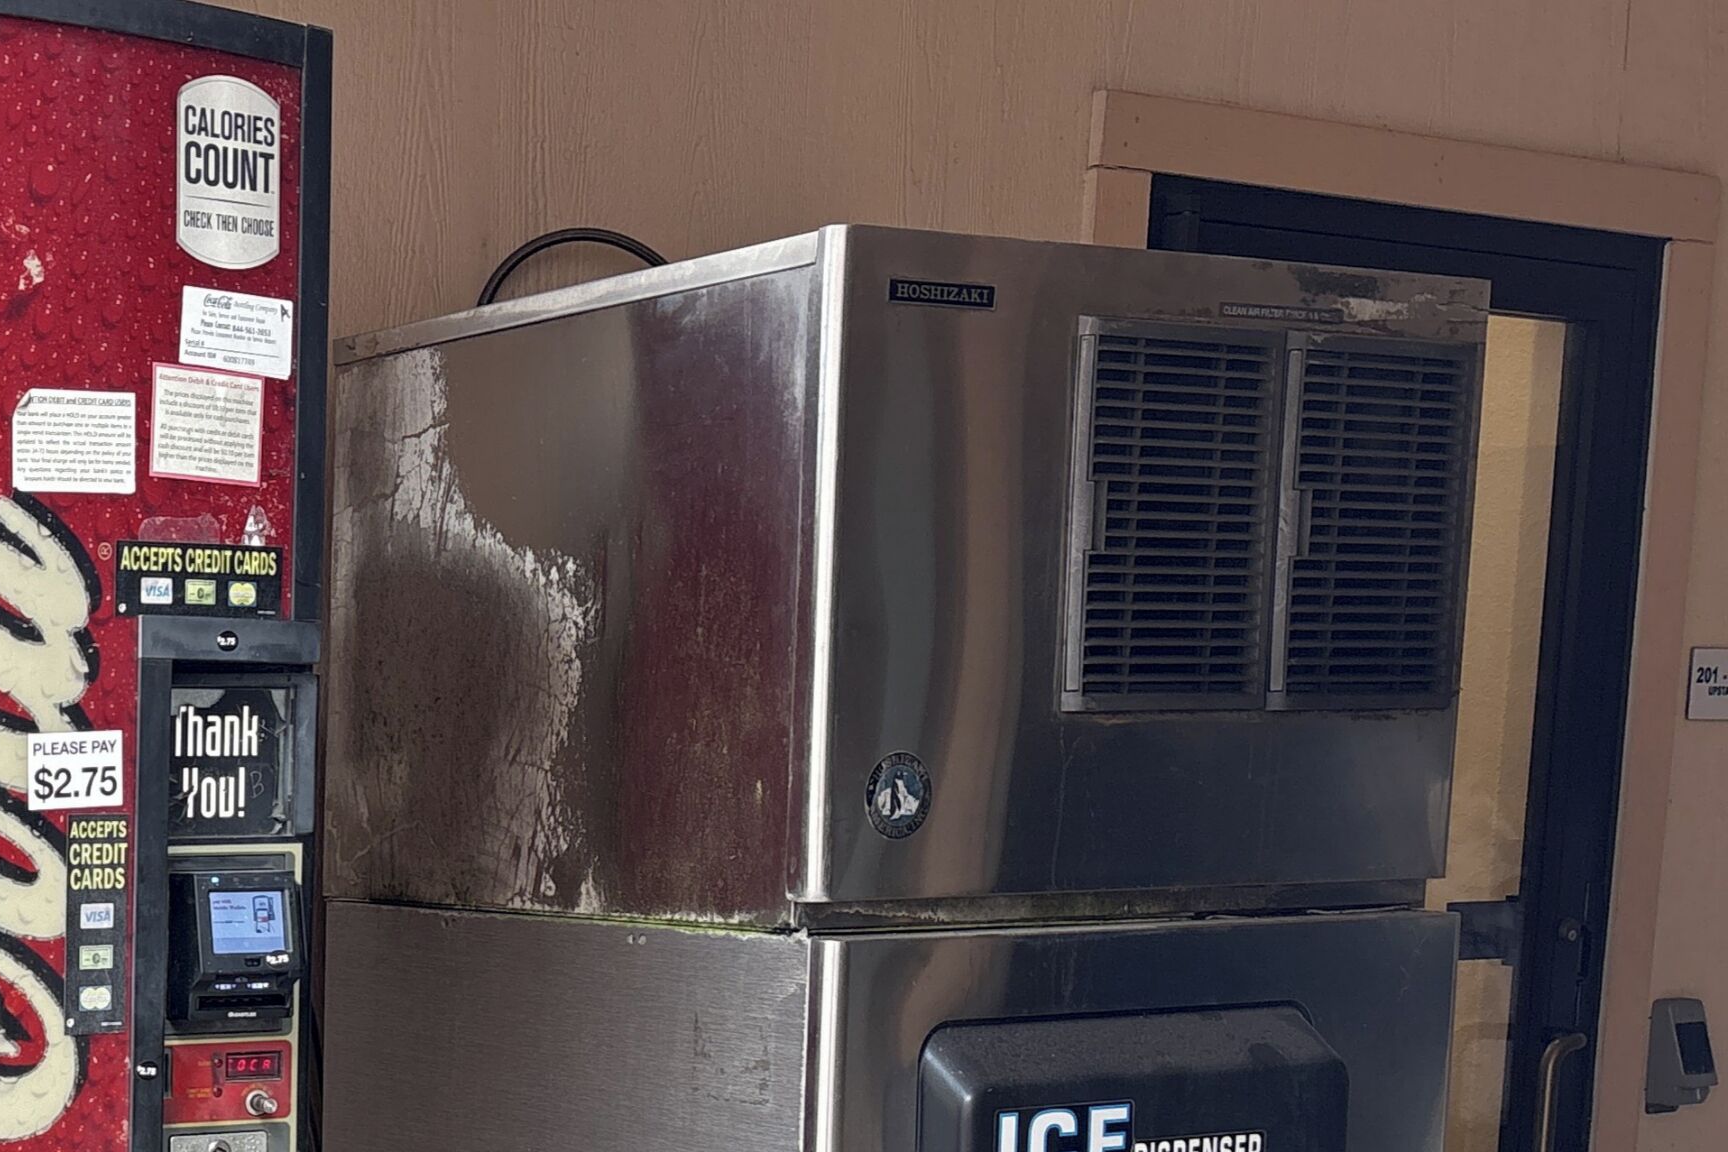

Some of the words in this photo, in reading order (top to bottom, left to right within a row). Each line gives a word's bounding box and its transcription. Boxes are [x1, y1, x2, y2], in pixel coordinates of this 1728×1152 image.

[184, 104, 276, 147] CALORIES
[184, 141, 276, 194] COUNT
[183, 210, 212, 230] CHECK
[216, 213, 238, 234] THEN
[241, 217, 275, 238] CHOOSE
[896, 283, 990, 304] HOSHIZAKI
[1223, 305, 1247, 315] CLEAN
[1248, 307, 1261, 316] AIR
[120, 545, 183, 572] ACCEPTS
[185, 548, 232, 574] CREDIT
[234, 551, 277, 575] CARDS
[145, 584, 170, 598] VISA
[1696, 666, 1719, 684] 201
[174, 705, 259, 757] Thank
[32, 740, 88, 757] PLEASE
[91, 739, 117, 753] PAY
[34, 765, 118, 803] $2.75
[182, 767, 245, 818] You!
[70, 820, 127, 839] ACCEPTS
[69, 842, 128, 866] CREDIT
[70, 867, 125, 890] CARDS
[84, 910, 111, 923] VISA
